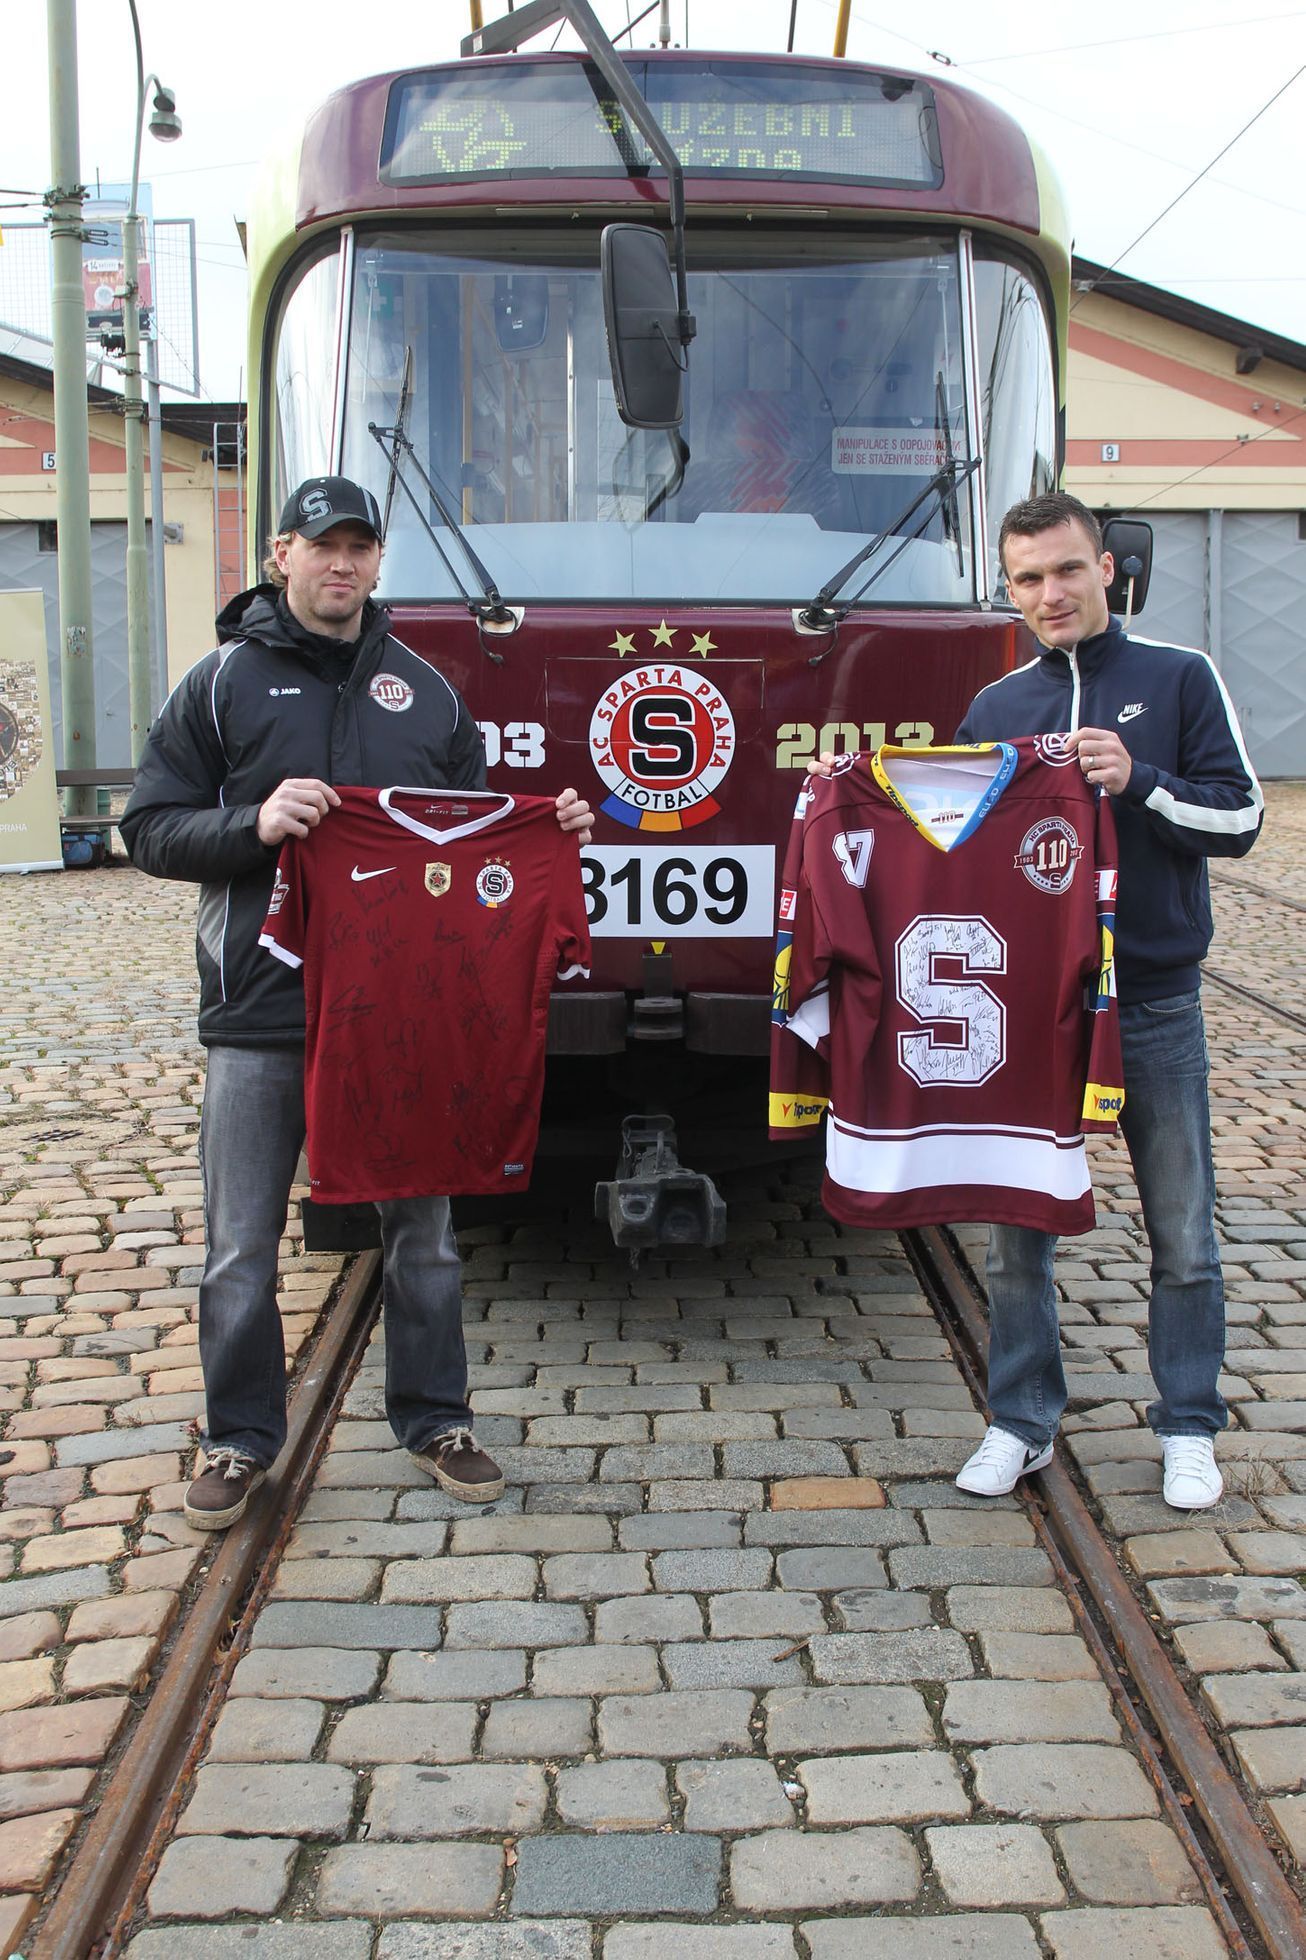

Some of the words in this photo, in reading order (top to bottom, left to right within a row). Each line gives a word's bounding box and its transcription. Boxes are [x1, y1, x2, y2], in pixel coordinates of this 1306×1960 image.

[836, 438, 889, 450] MANIPULACE
[891, 439, 897, 449] S
[1105, 445, 1115, 460] 9
[47, 454, 56, 468] 5
[838, 453, 853, 465] JEN
[856, 453, 867, 465] SE
[869, 450, 912, 466] STAŽENÝM
[299, 488, 333, 523] S
[280, 687, 302, 696] JAKO
[378, 684, 404, 700] 110
[597, 668, 684, 722] SPARTA
[1122, 702, 1144, 715] NIKE
[629, 695, 698, 780] S
[694, 682, 732, 768] PRAHA
[592, 737, 615, 767] AC
[621, 783, 702, 810] FOTBAL
[1036, 838, 1068, 871] 110
[486, 872, 504, 895] S
[579, 857, 749, 926] 8169
[895, 914, 1008, 1089] S
